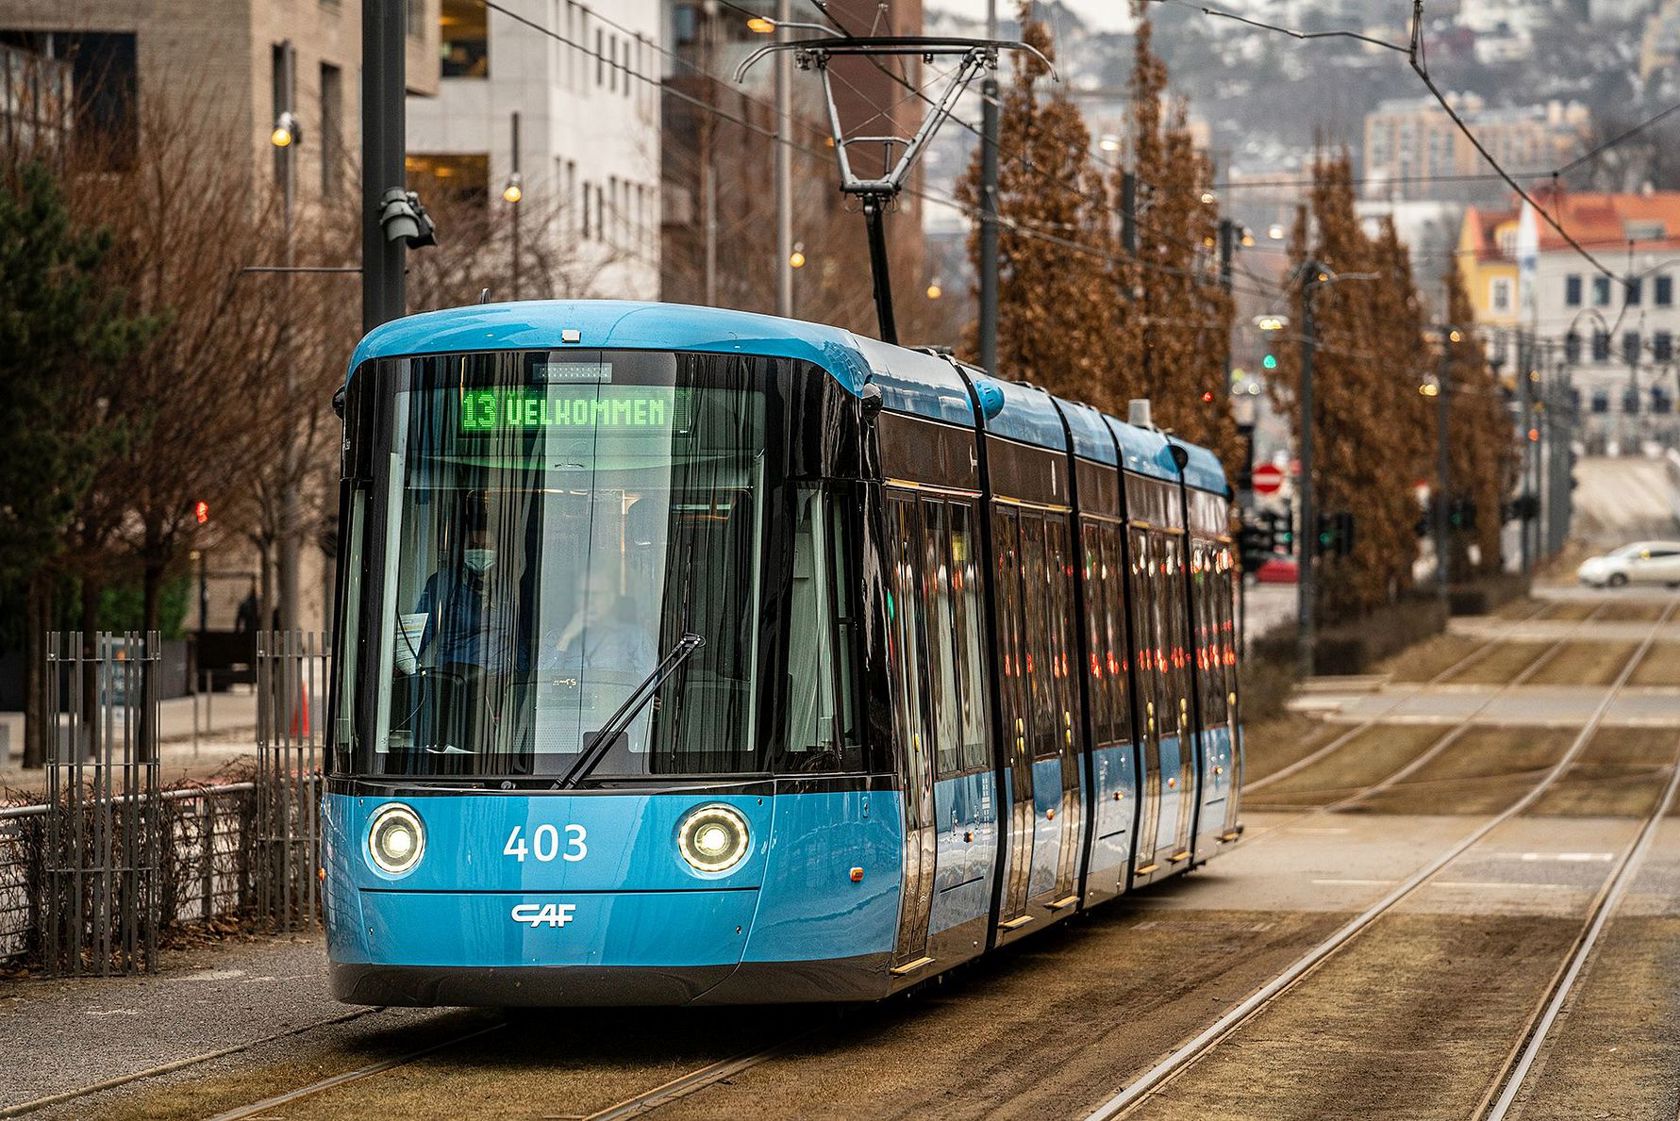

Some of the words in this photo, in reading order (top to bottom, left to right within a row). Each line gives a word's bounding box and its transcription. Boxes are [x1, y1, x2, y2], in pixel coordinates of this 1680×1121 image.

[463, 394, 497, 427] 13
[503, 824, 588, 862] 403
[511, 903, 577, 928] CAF
